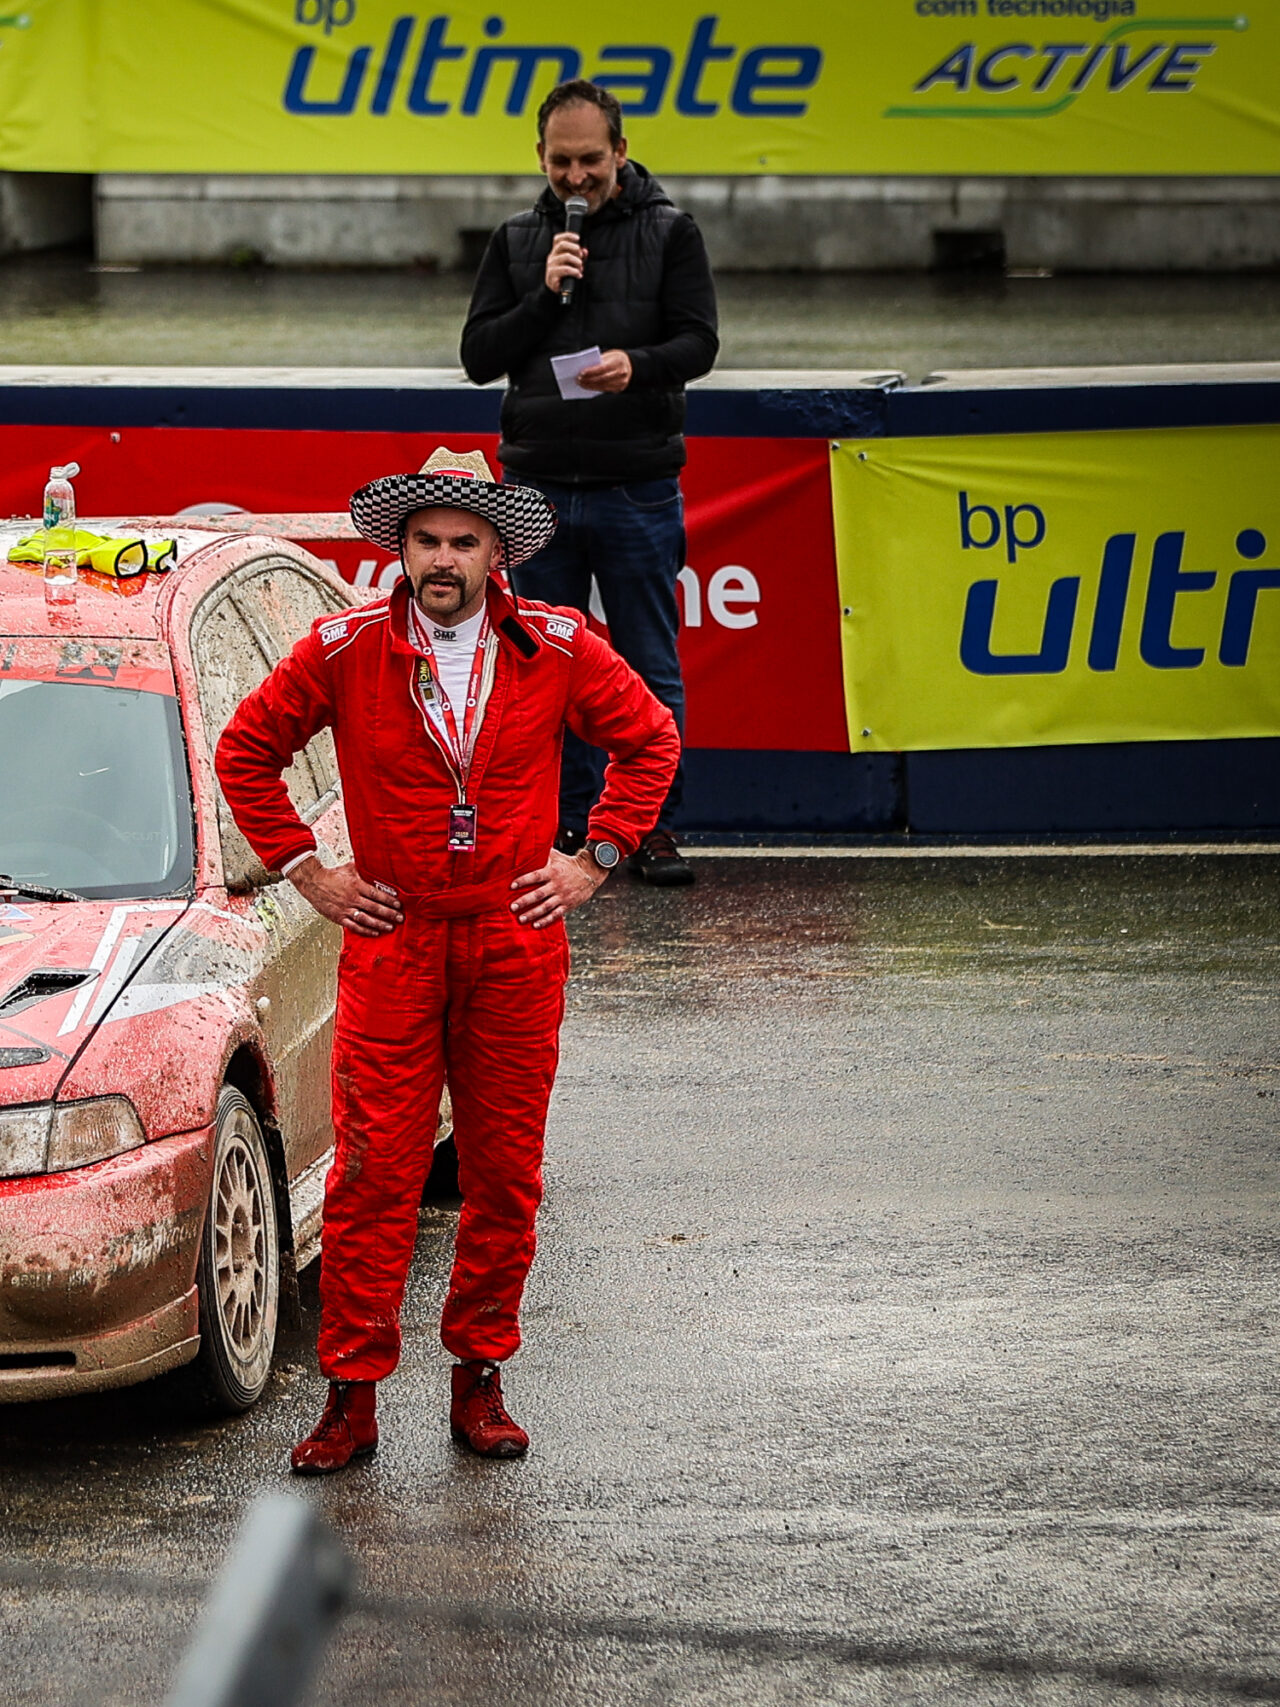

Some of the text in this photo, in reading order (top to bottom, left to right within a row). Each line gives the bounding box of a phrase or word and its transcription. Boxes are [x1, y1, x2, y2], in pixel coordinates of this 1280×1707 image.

[283, 15, 823, 117] ultimate
[913, 42, 1218, 93] ACTIVE
[958, 491, 1047, 563] bp
[959, 528, 1280, 677] ulti
[320, 624, 348, 643] OMP
[433, 630, 457, 641] OMP
[546, 621, 575, 638] OMP
